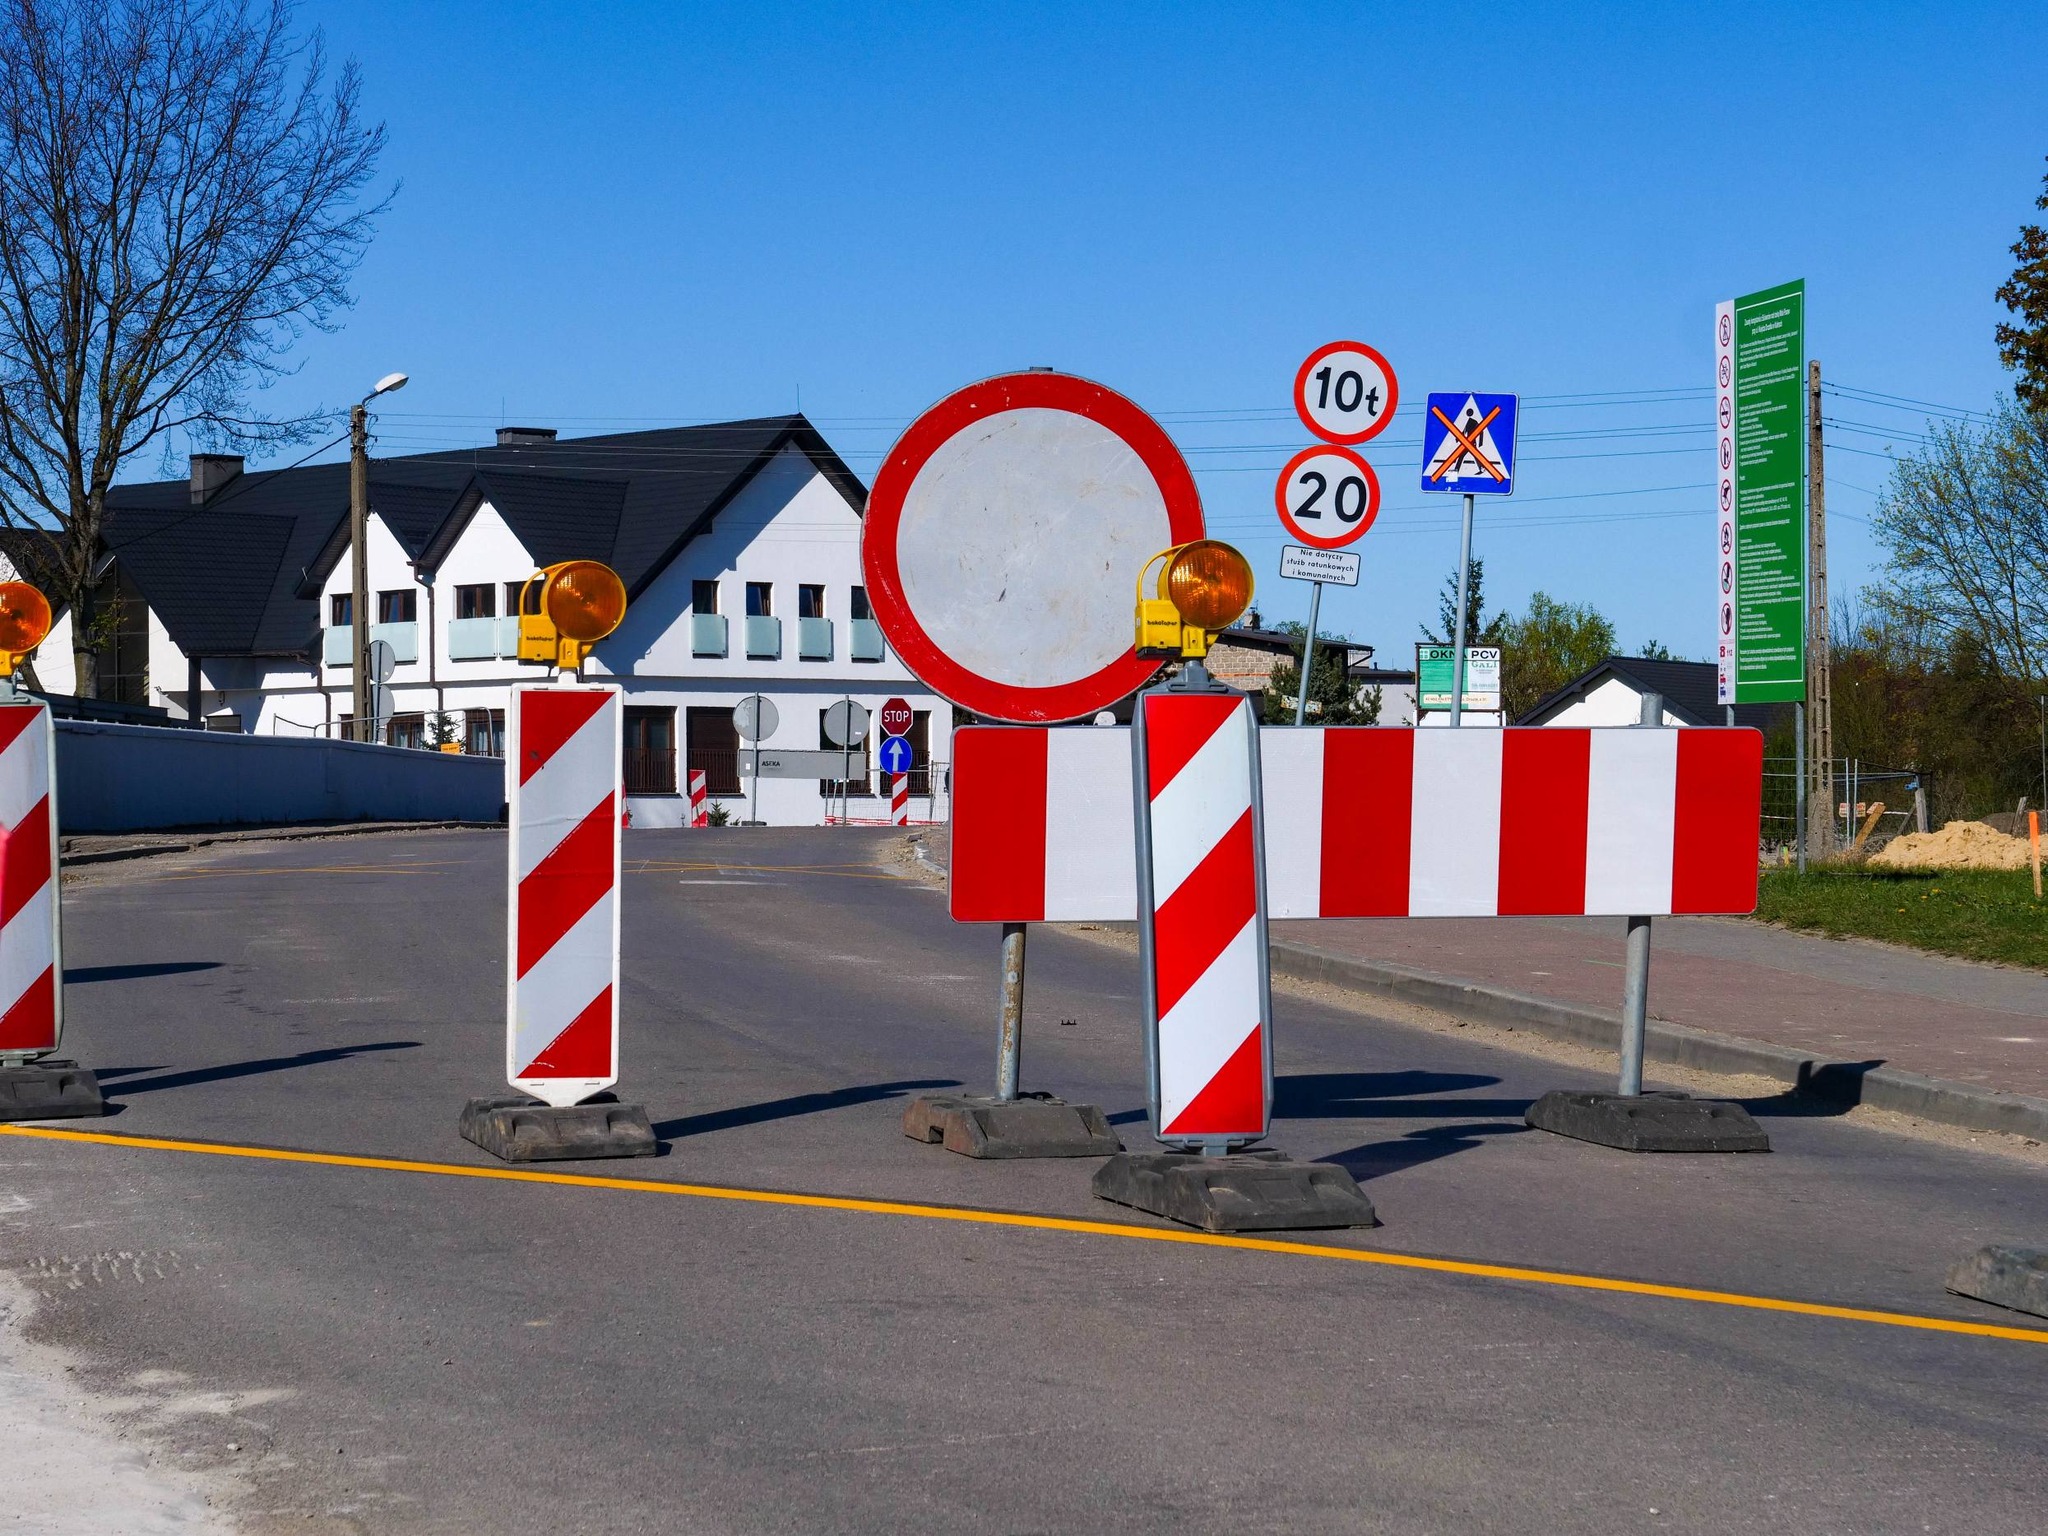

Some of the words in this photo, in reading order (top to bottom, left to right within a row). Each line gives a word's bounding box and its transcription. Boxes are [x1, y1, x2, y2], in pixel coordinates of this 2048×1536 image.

[1294, 471, 1367, 523] 20
[1300, 549, 1313, 557] Nie
[1315, 550, 1344, 562] dotyczy
[1286, 558, 1306, 566] służb
[1307, 561, 1354, 573] ratunkowych
[1297, 569, 1346, 582] komunalnych
[1471, 650, 1498, 659] PCV
[884, 710, 910, 723] STOP
